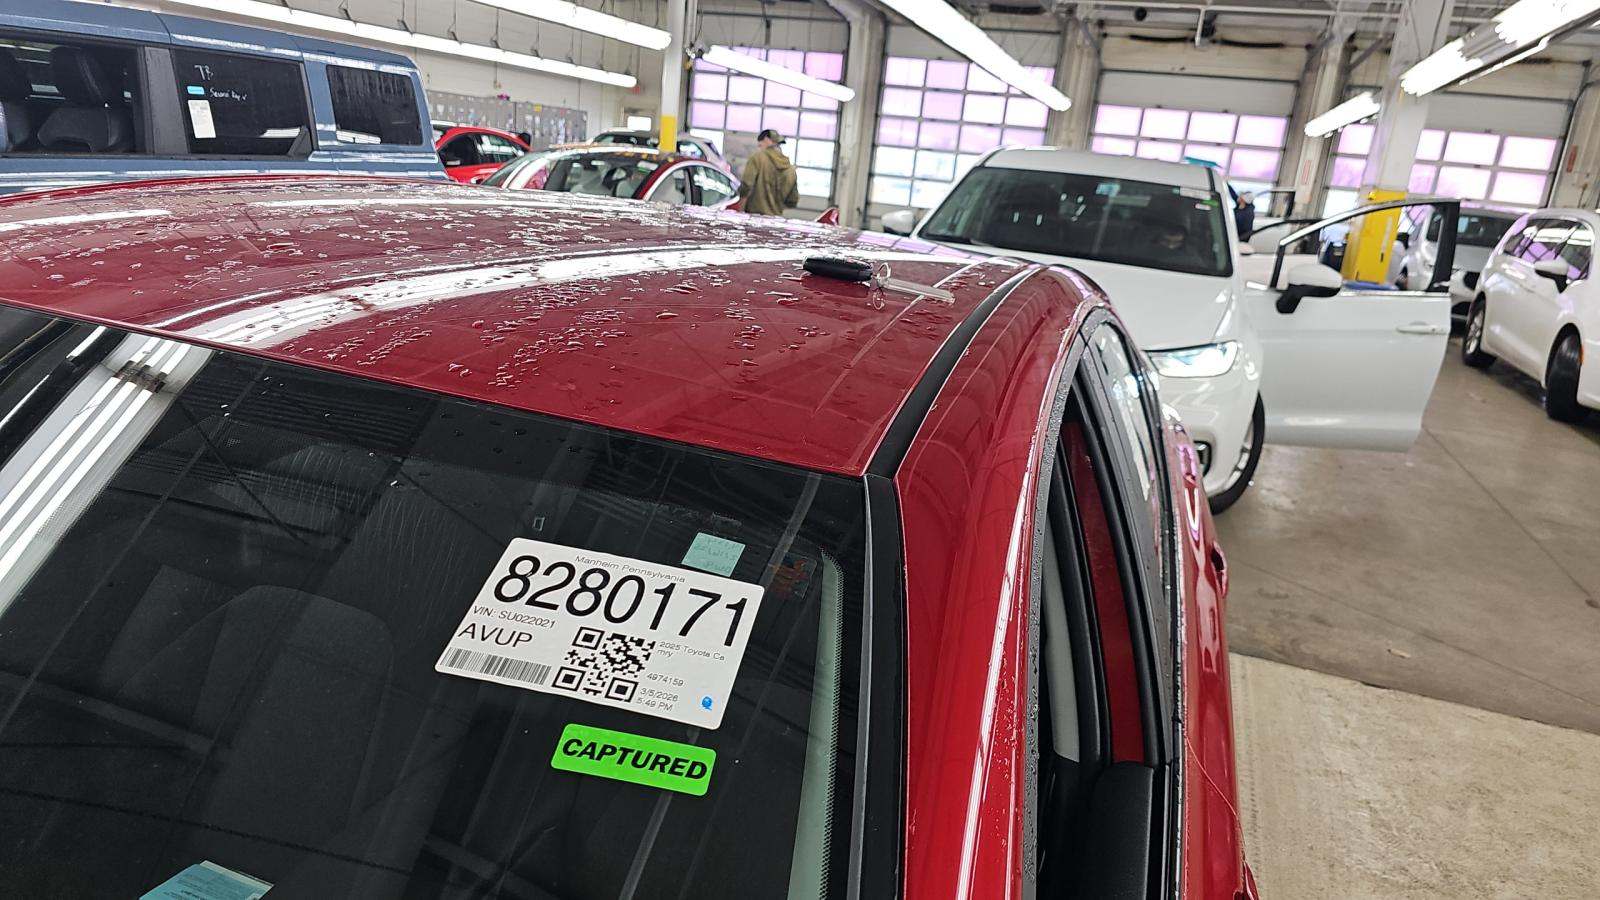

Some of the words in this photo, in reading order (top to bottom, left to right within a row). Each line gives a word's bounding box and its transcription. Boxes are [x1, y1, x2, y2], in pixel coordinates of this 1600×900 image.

[575, 555, 619, 570] Manheim
[622, 564, 686, 583] Pennsylvania
[493, 555, 748, 647] 8280171
[472, 605, 497, 618] VIN:
[498, 610, 556, 629] SU022021
[458, 623, 533, 648] AVUP
[657, 649, 674, 658] mry
[659, 641, 681, 652] 2025
[683, 645, 711, 658] Toyota
[713, 652, 725, 661] Ca
[647, 672, 684, 687] 4974159
[636, 697, 656, 708] 5:49
[657, 701, 673, 712] PM
[562, 738, 708, 781] CAPTURED
